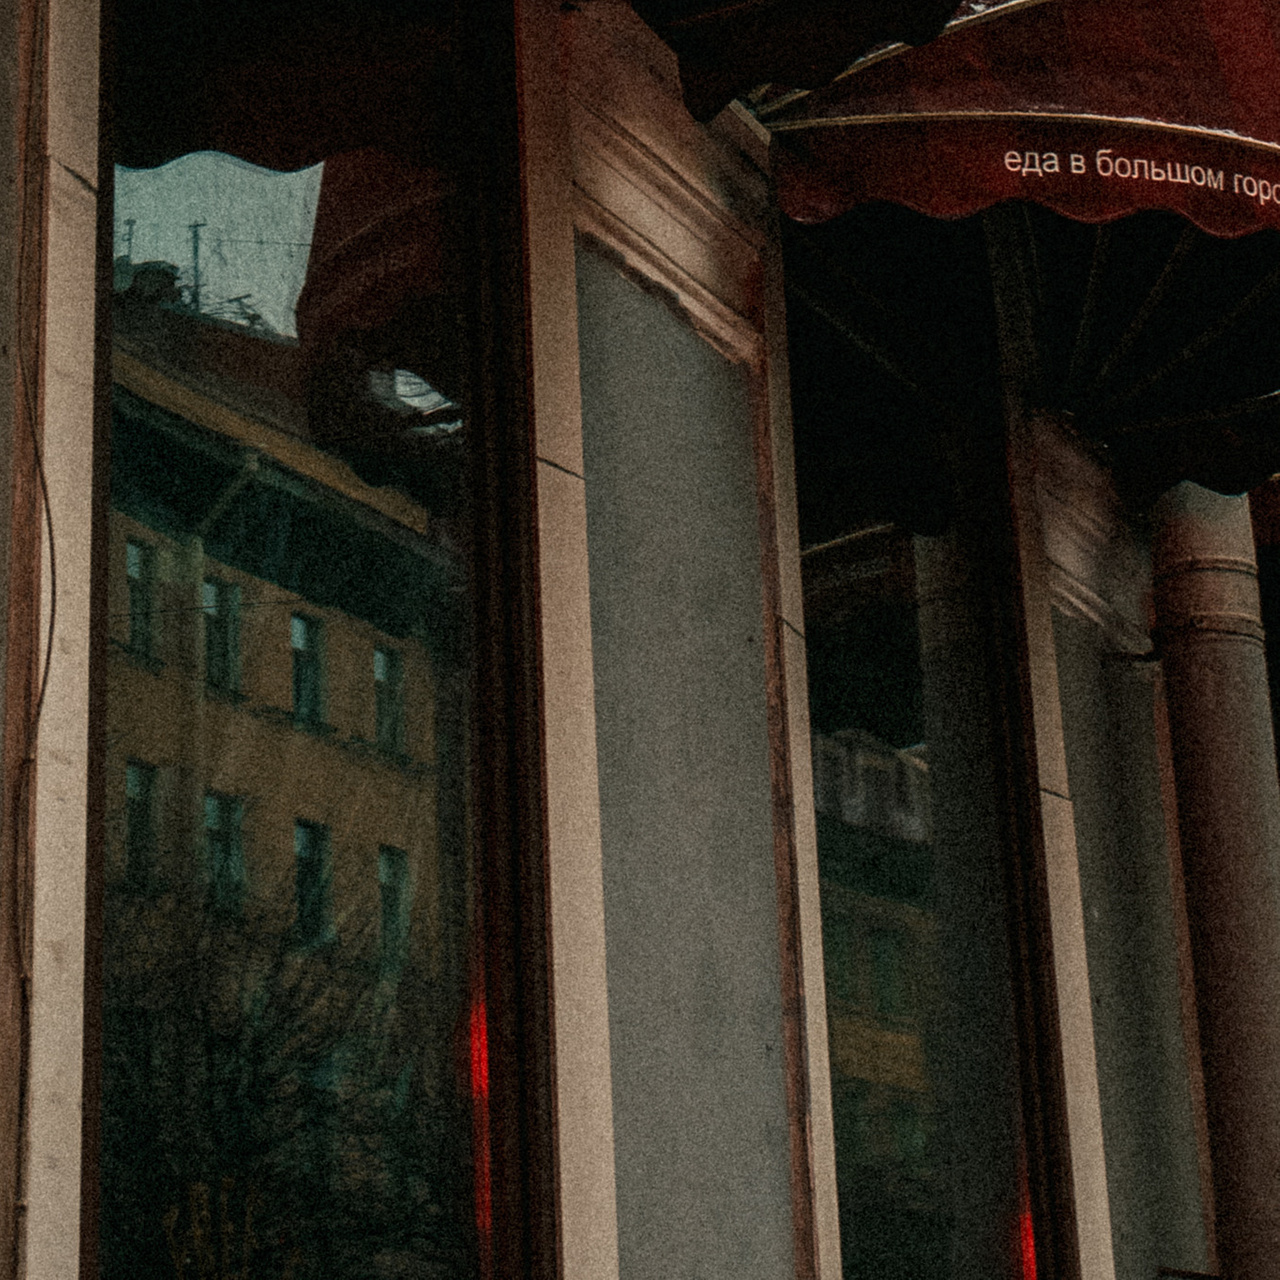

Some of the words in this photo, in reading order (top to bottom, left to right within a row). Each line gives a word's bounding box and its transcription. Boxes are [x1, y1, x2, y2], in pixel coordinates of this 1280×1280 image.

[1004, 149, 1060, 177] еда
[1070, 152, 1086, 174] в
[1095, 148, 1225, 191] большом
